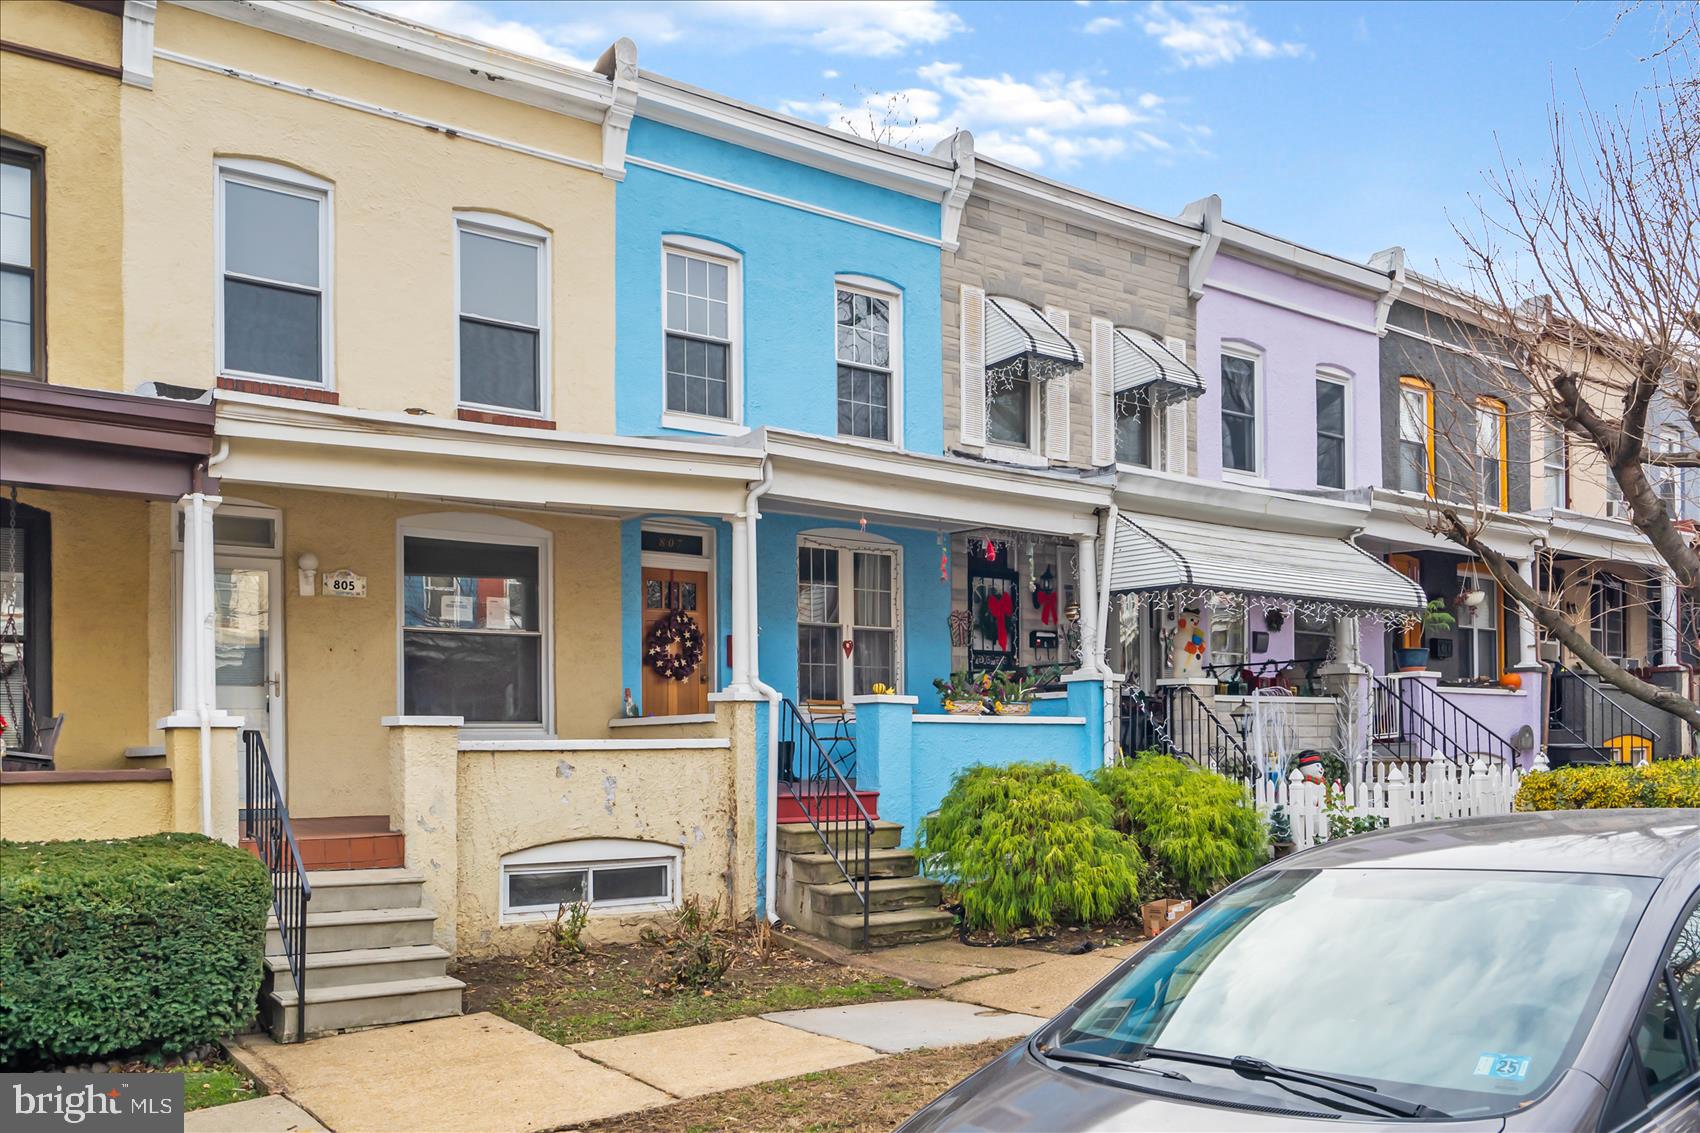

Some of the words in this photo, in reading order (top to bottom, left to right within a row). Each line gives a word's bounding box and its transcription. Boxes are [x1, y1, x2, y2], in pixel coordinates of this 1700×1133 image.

[658, 537, 682, 550] 807
[333, 580, 355, 591] 805
[1496, 1060, 1519, 1074] 25
